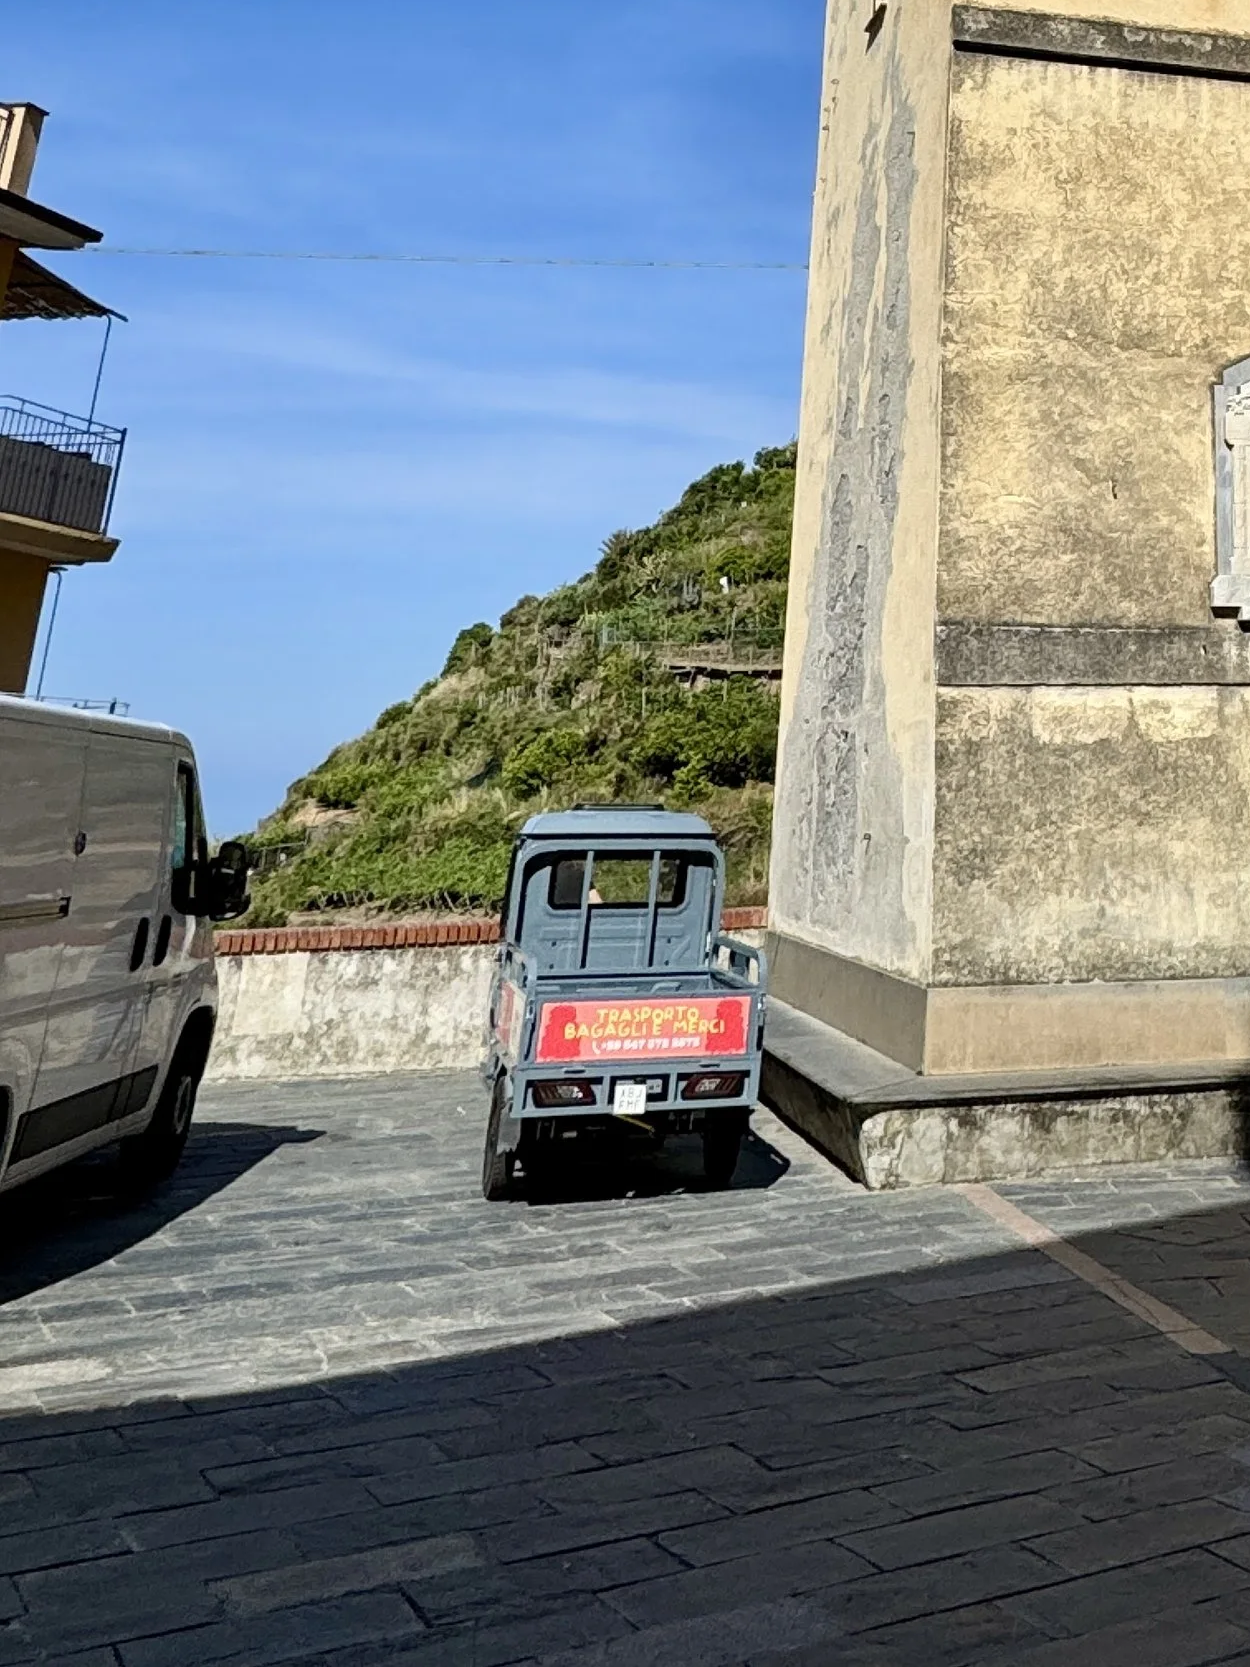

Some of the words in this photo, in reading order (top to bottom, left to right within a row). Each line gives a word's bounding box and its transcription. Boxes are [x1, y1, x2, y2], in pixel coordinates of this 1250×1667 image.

[597, 1005, 699, 1024] TRASPORTO
[564, 1020, 647, 1040] BAGAGLI
[652, 1019, 662, 1036] E
[673, 1018, 725, 1036] MERCI
